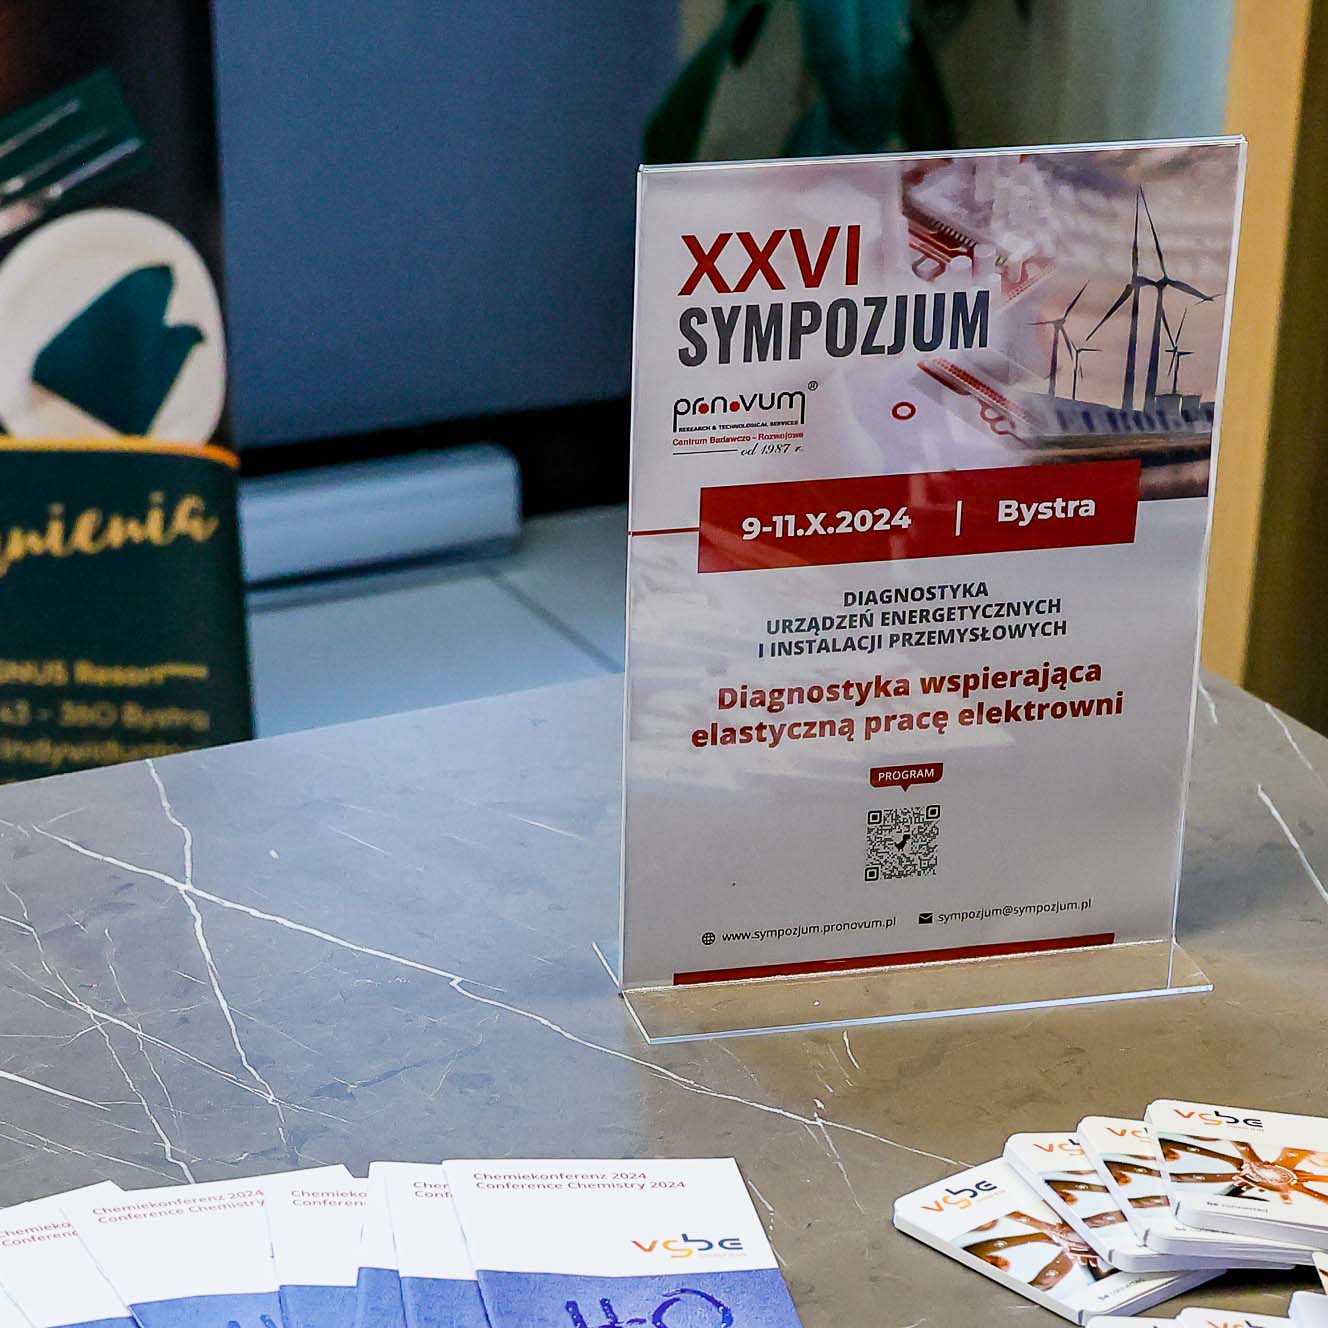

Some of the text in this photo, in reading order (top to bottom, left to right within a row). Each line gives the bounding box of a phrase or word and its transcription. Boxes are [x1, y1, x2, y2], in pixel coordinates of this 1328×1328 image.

[678, 225, 860, 296] XXVI
[678, 290, 990, 367] SYMPOZJUM
[673, 432, 804, 446] Centrum Badawczo Rozwojowe
[741, 443, 791, 456] od 1987
[741, 497, 1095, 541] 9-11.X.2024 Bystra
[843, 581, 989, 608] DIAGNOSTYKA
[766, 598, 1062, 637] URZĄDZEŃ ENERGETYCZNYCH
[758, 620, 1067, 658] I INSTALACJI PRZEMYSŁOWYCH
[717, 661, 1102, 714] Diagnostyka wspierająca
[691, 691, 1124, 749] elastyczną pracę elektrowni
[878, 767, 935, 782] PROGRAM
[722, 899, 1092, 943] www.sympozjum.pronovum.pl sympozjum@sympozjum.pl
[1174, 1109, 1264, 1128] vgbe
[473, 1171, 648, 1182] Chemiekonferenz 2024
[476, 1180, 686, 1192] Conference Chemistry 2024
[92, 1188, 265, 1216] Chemiekonferenz 2024
[921, 1180, 998, 1210] vgbe
[97, 1199, 266, 1224] Conference Chemistry
[630, 1234, 745, 1258] vgbe
